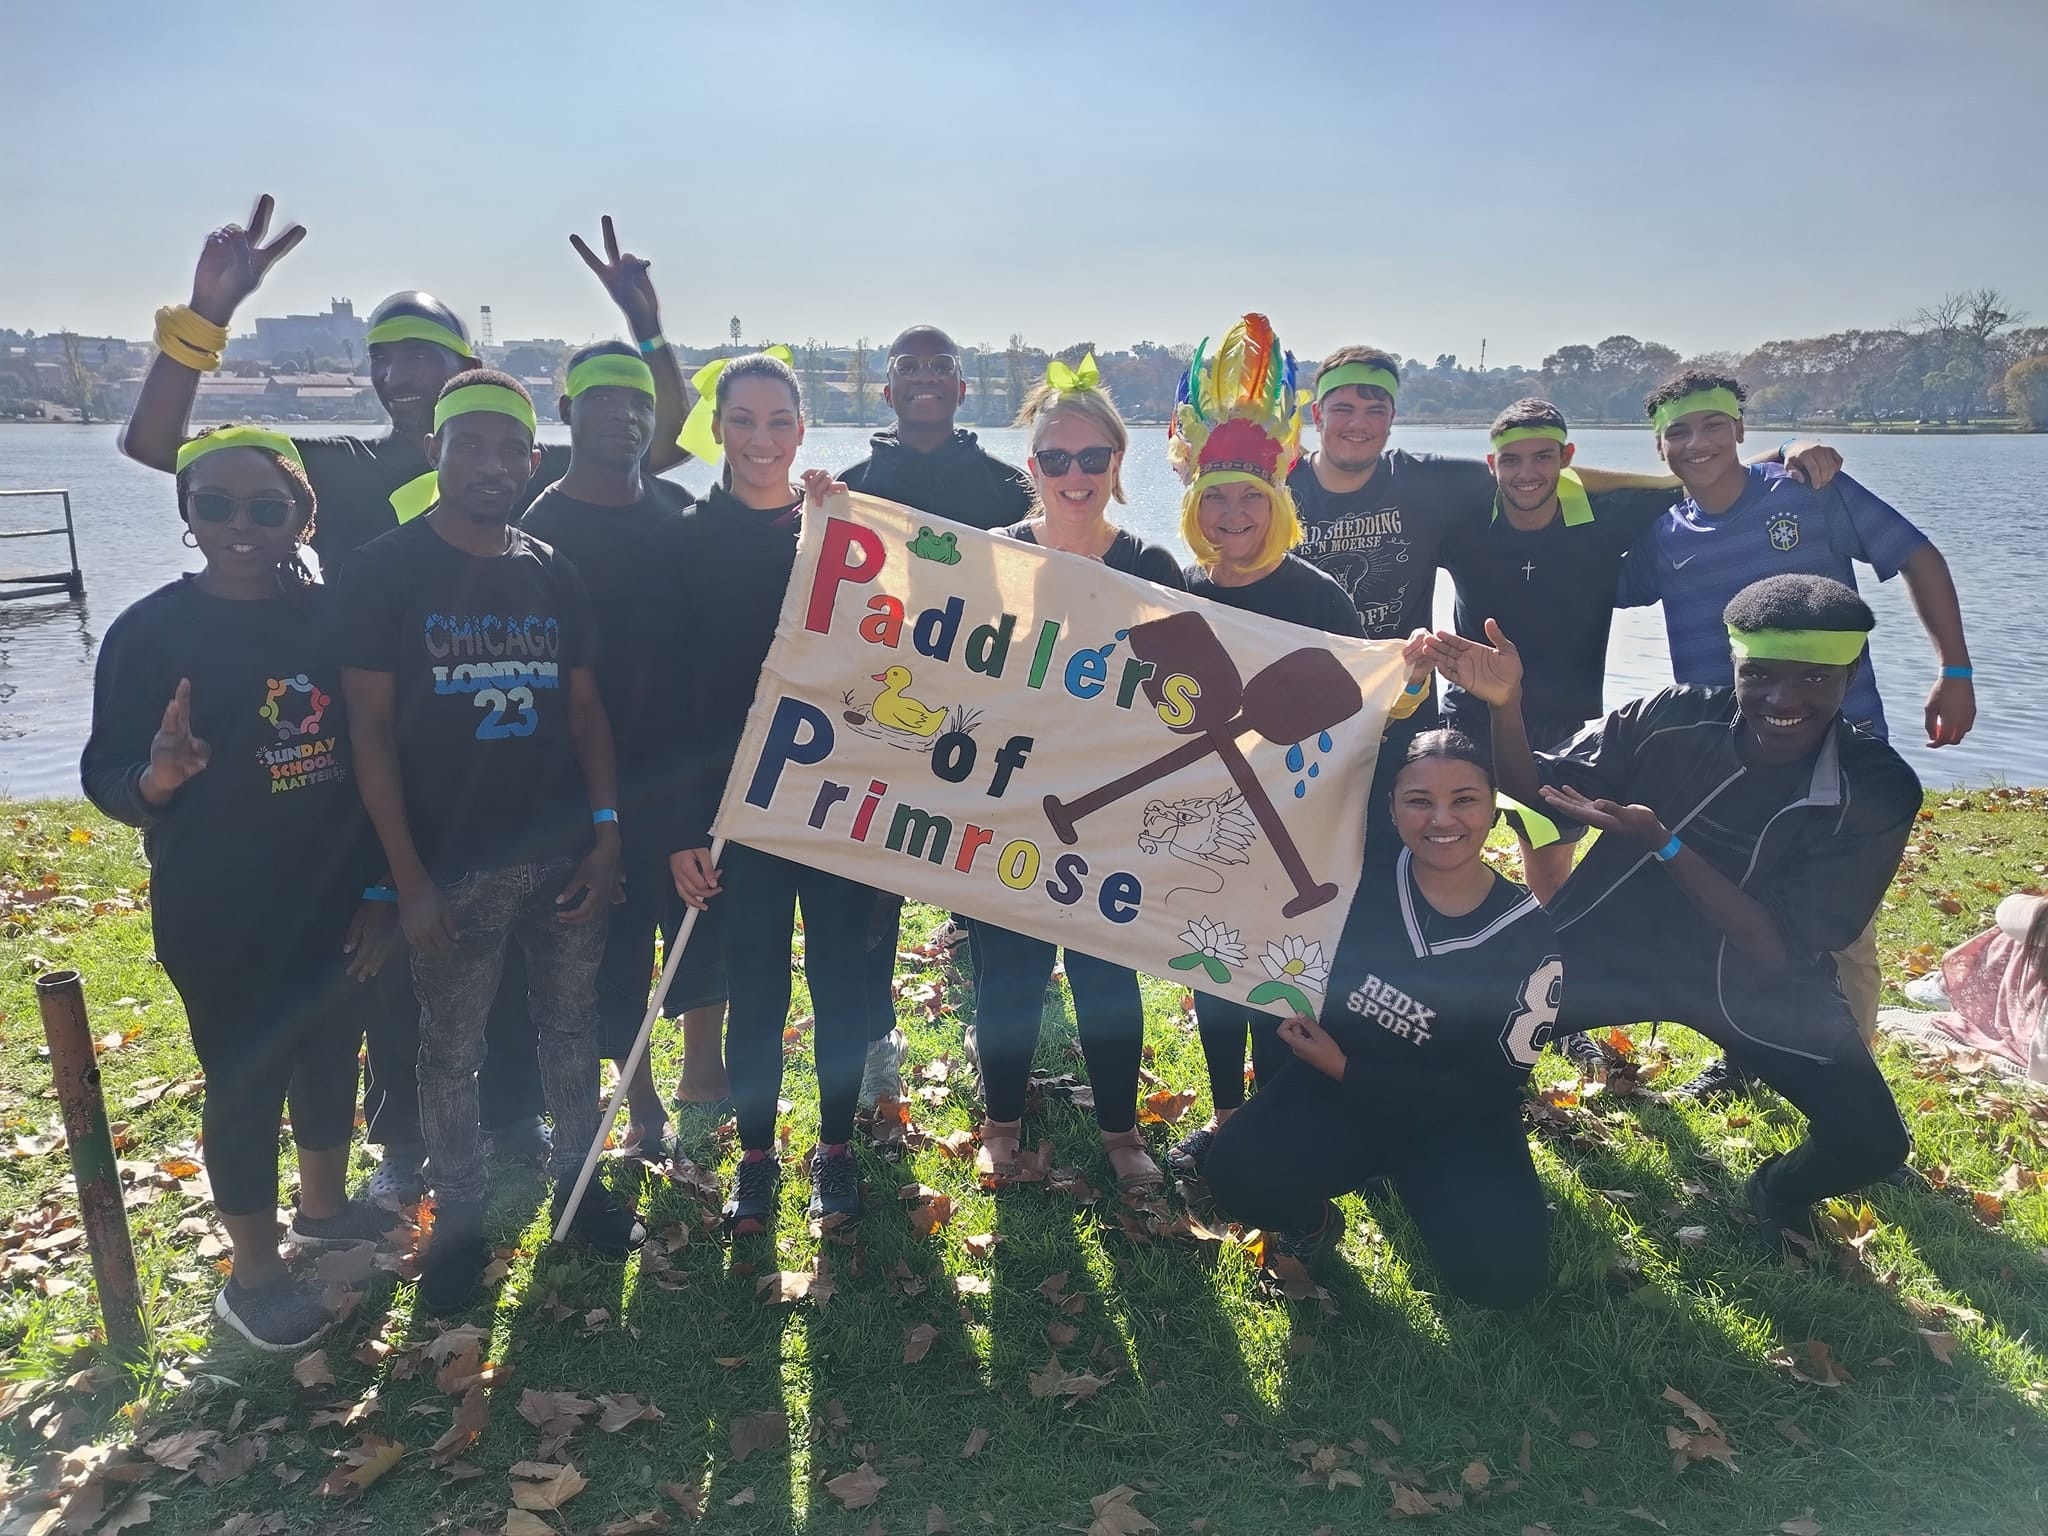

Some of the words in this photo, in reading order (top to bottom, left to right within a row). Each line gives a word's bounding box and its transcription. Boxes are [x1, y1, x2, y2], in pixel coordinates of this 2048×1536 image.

[1324, 510, 1402, 541] SHEDDING
[1331, 535, 1382, 552] MOERSE
[424, 612, 560, 659] CHICAGO
[803, 516, 1201, 728] Paddlers
[432, 660, 559, 695] LONDON
[473, 686, 539, 741] 23
[264, 737, 336, 765] SUNDAY
[270, 753, 335, 780] SCHOOL
[930, 734, 1034, 800] of
[271, 766, 339, 794] MATTERS
[743, 695, 1144, 925] Primrose
[1346, 990, 1433, 1047] SPORT
[1358, 972, 1438, 1031] REDX
